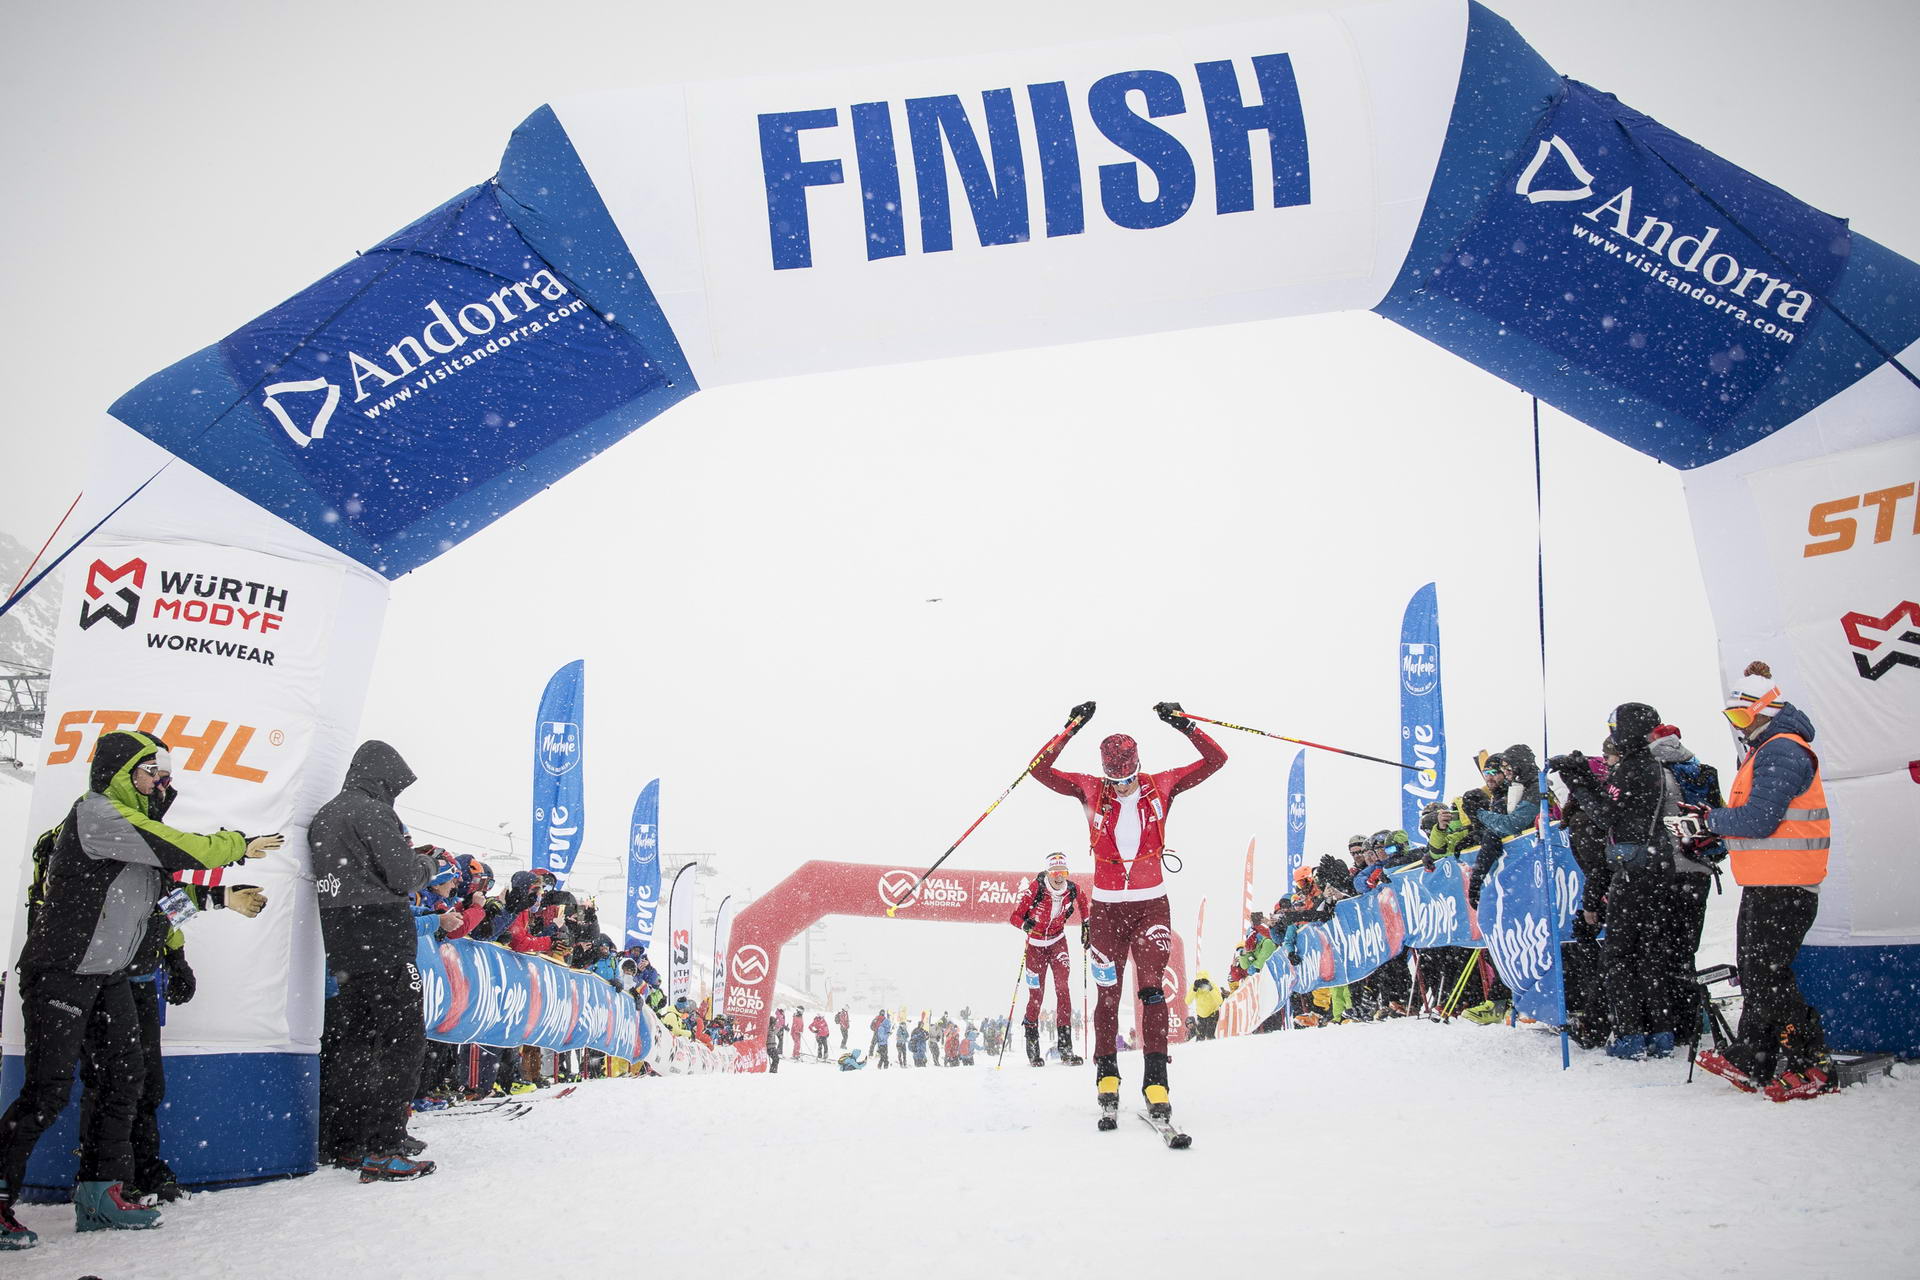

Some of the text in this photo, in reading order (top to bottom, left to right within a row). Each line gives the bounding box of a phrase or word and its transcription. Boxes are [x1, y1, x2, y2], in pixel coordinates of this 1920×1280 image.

[757, 52, 1311, 270] FINISH
[1582, 185, 1813, 324] Andorra
[1572, 224, 1795, 345] www.visitandorra.com
[349, 268, 569, 403] Andorra
[364, 299, 588, 420] www.visitandorra.com
[160, 570, 289, 612] WÜRTH
[152, 597, 284, 634] MODYF
[146, 633, 275, 666] WORKWEAR
[1403, 655, 1437, 681] Marlene
[924, 889, 1025, 904] NORD ARINS
[925, 879, 1009, 892] VALL PAL
[727, 995, 764, 1010] NORD
[730, 985, 761, 999] VALL
[727, 1006, 758, 1015] ANDORRA
